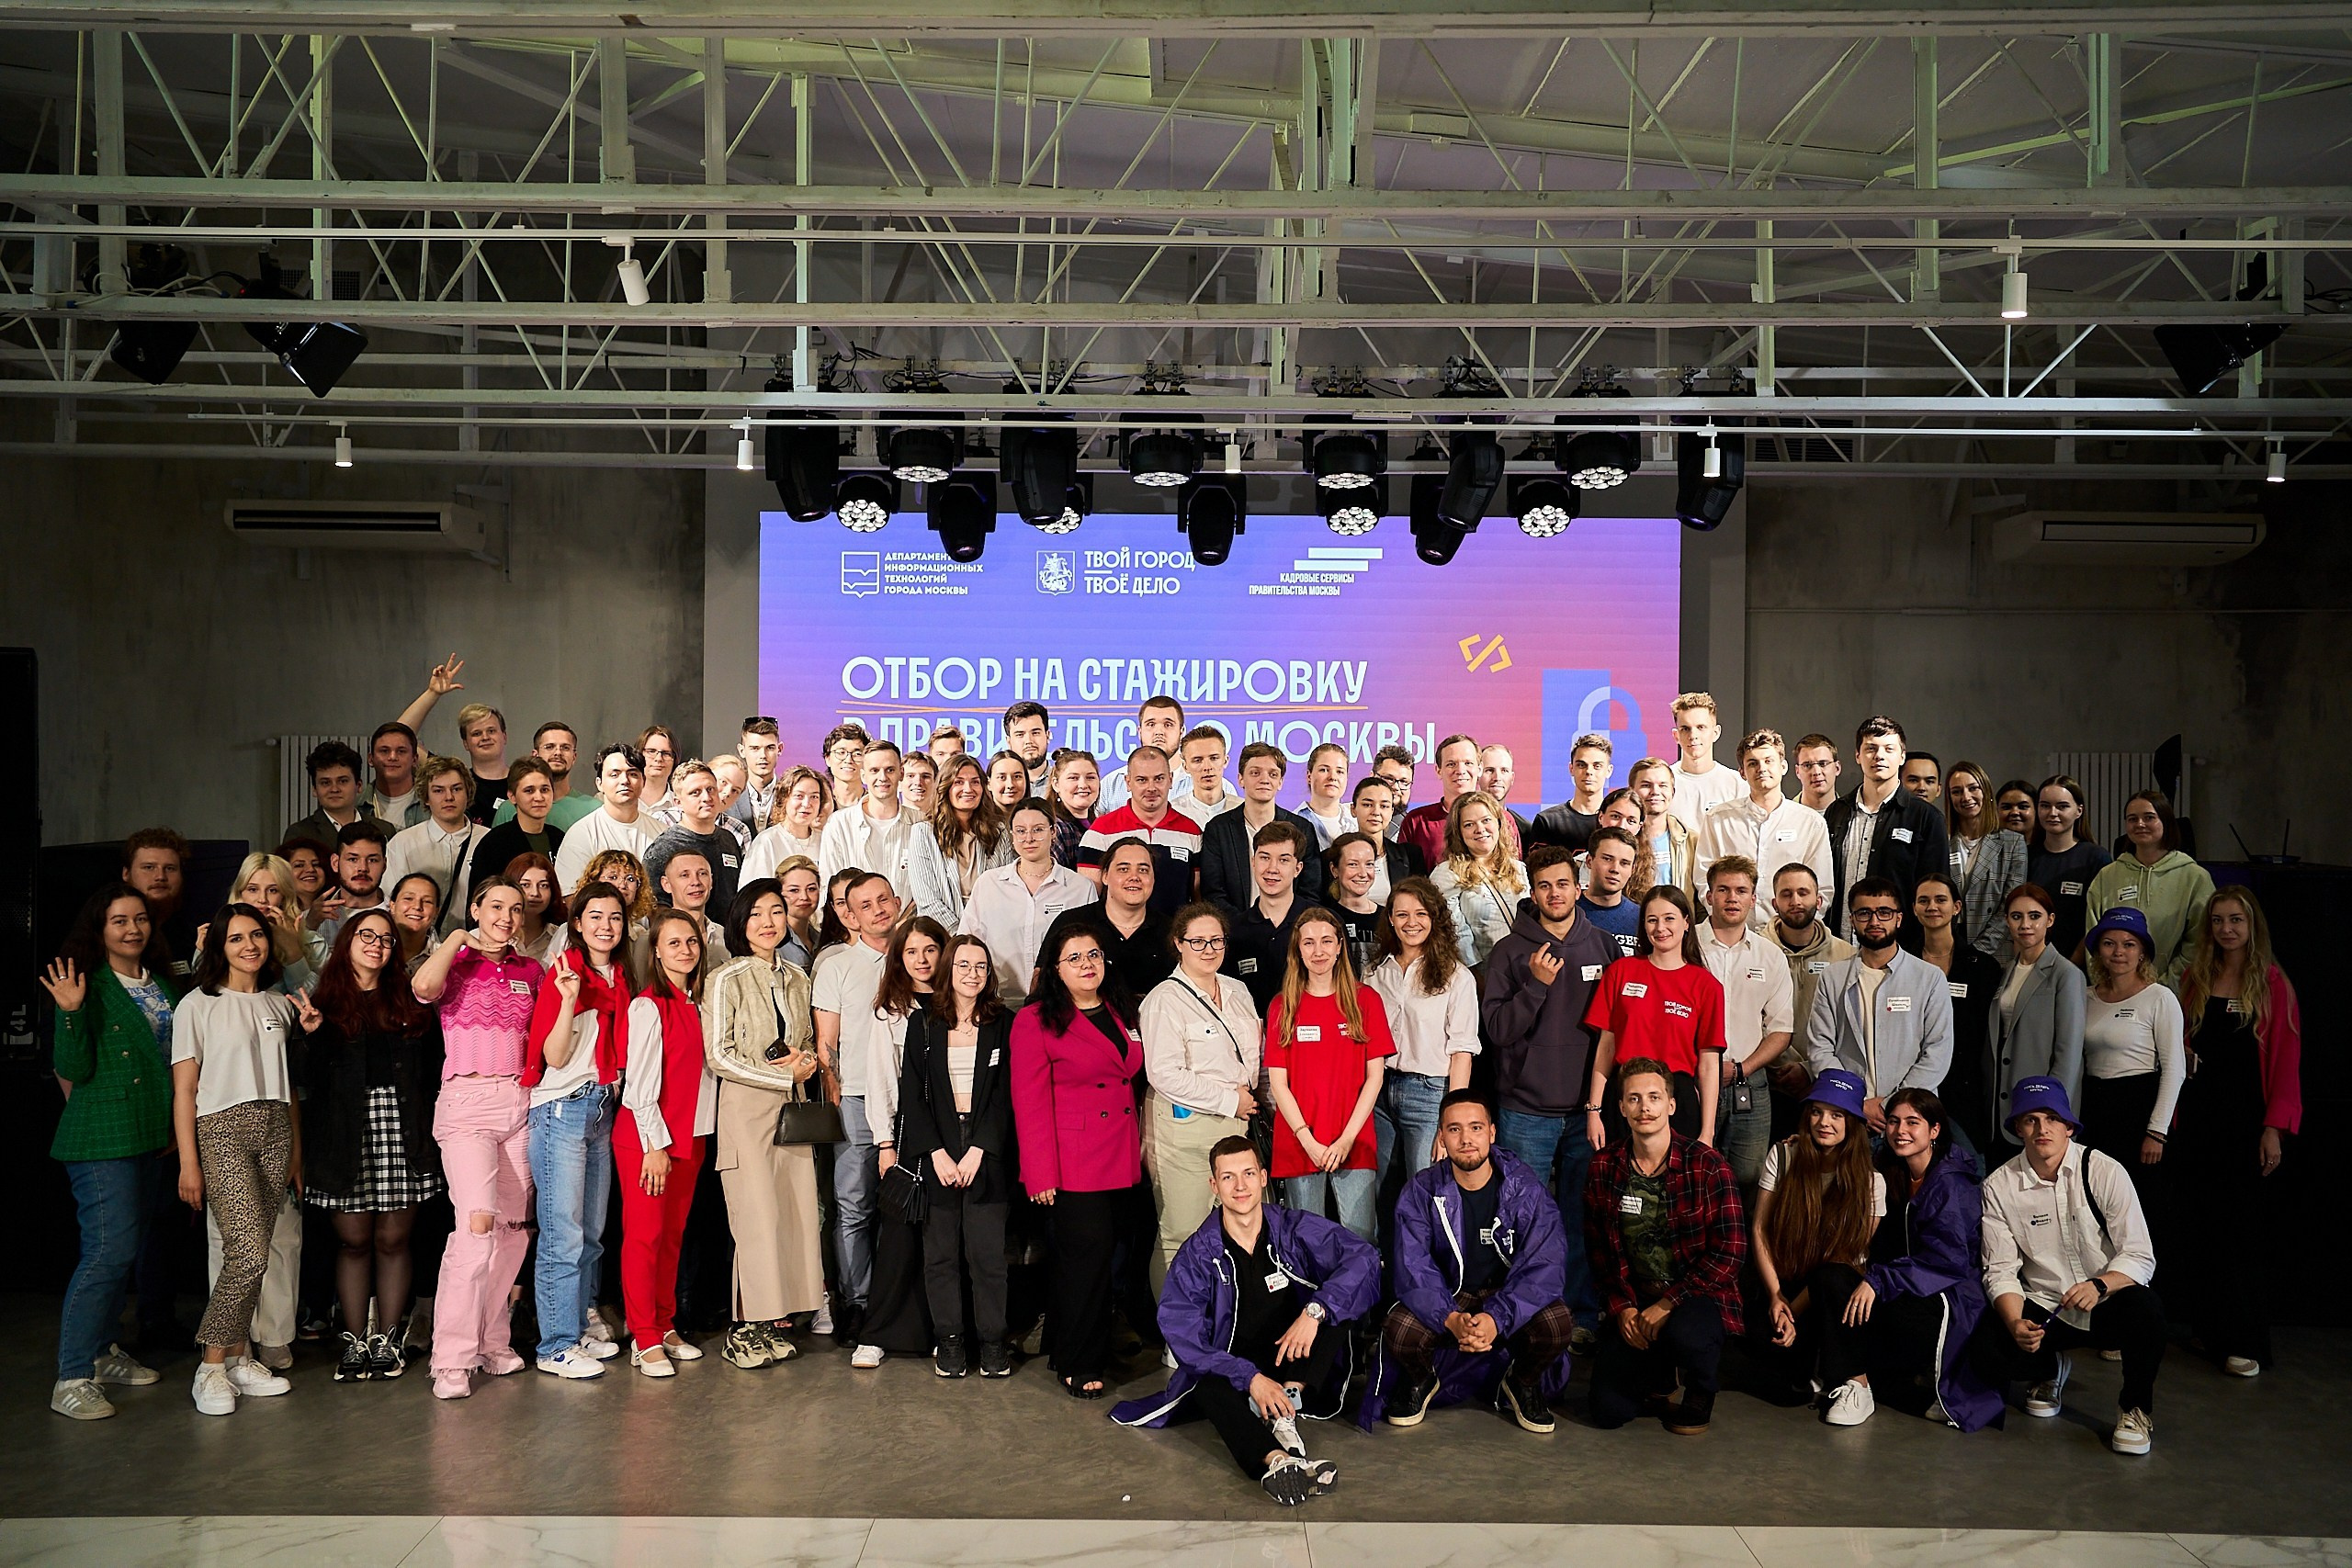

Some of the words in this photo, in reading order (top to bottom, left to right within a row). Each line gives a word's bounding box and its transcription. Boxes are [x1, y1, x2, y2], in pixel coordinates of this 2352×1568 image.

[1083, 546, 1130, 569] ТВОЙ
[1134, 550, 1195, 572] ГОРОД
[884, 563, 984, 573] ИНФОРМАЦИОННЫХ
[884, 572, 948, 583] ТЕХНОЛОГИЙ
[1279, 572, 1319, 583] КАДРОВЫЕ
[1320, 573, 1355, 583] СЕРВИСЫ
[884, 585, 923, 595] ГОРОДА
[924, 585, 968, 595] МОСКВЫ
[1083, 572, 1129, 595] ТВОЁ
[1131, 576, 1182, 598] ДЕЛО
[1249, 584, 1308, 595] ПРАВИТЕЛЬСТВА
[1308, 586, 1340, 596] МОСКВЫ
[841, 656, 1002, 702] ОТБОР
[1014, 658, 1068, 702] НА
[1078, 658, 1369, 705] СТАЖИРОВКУ
